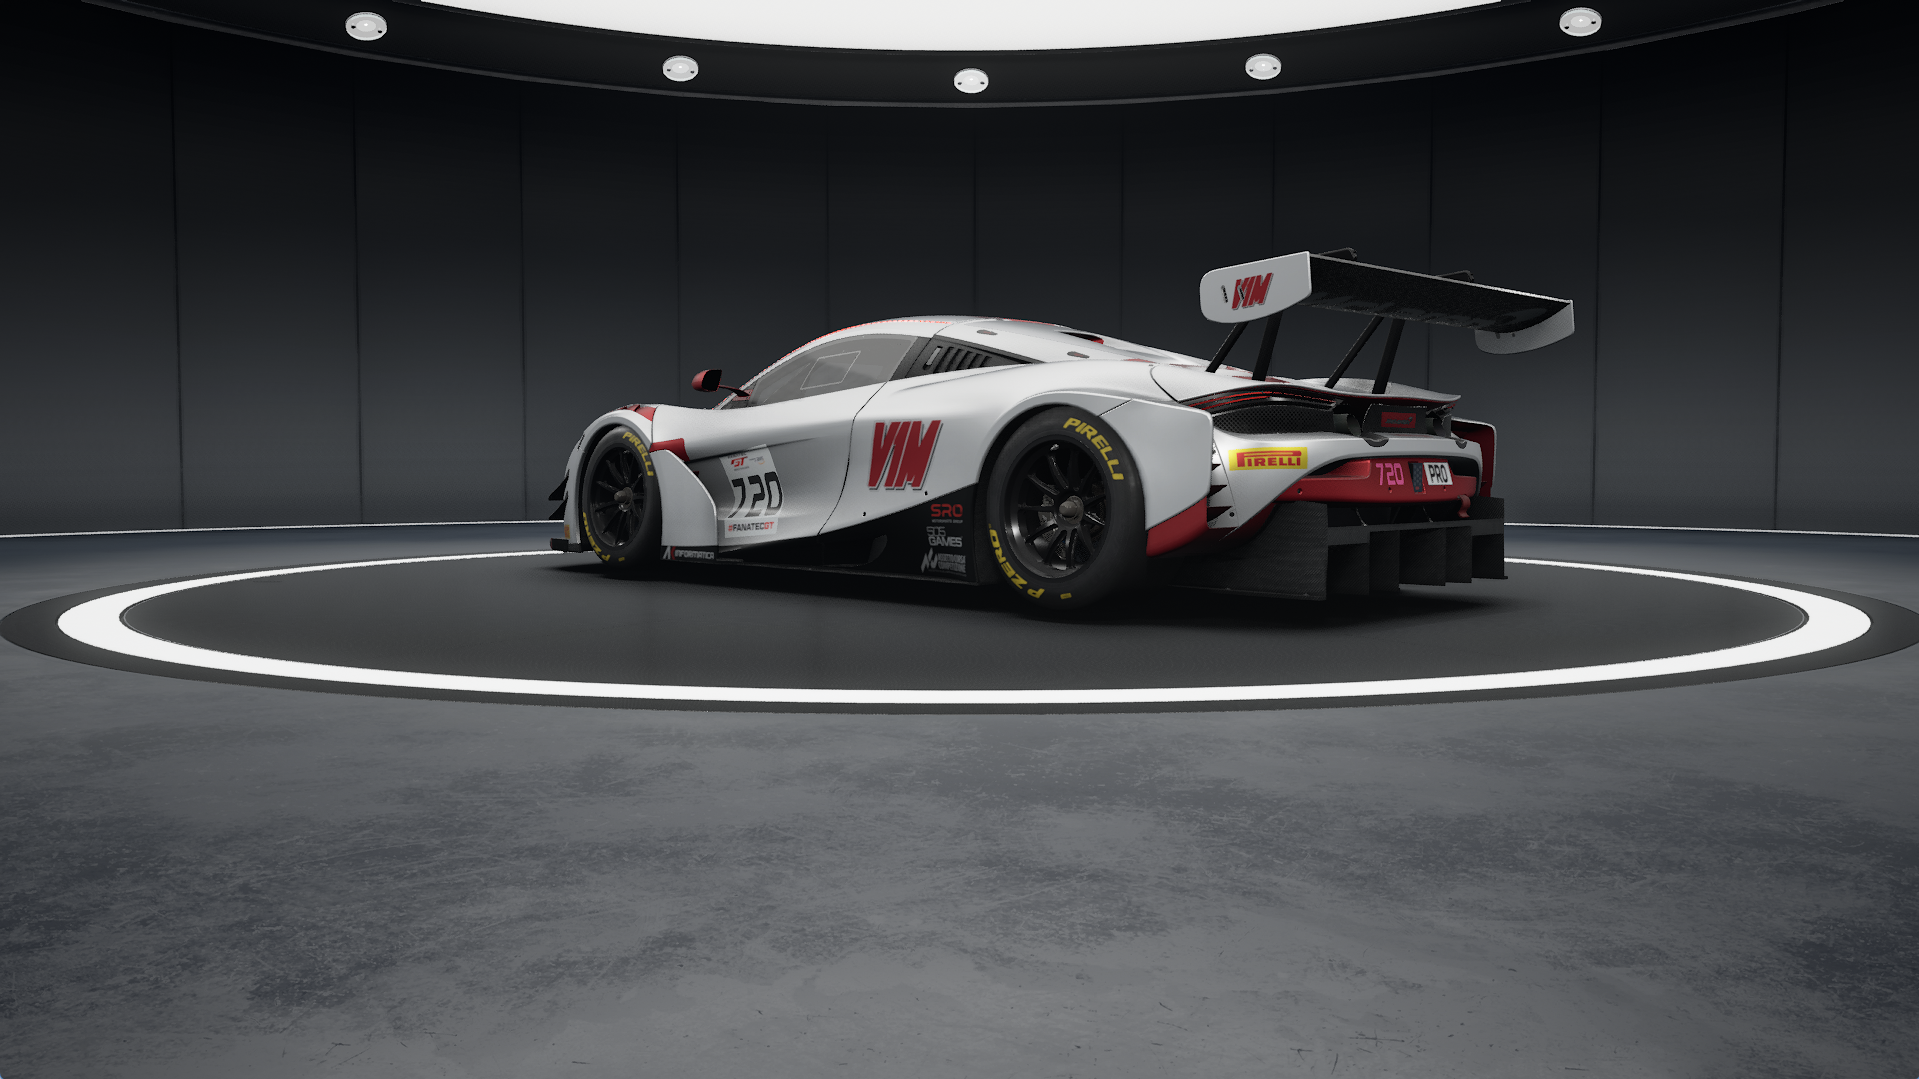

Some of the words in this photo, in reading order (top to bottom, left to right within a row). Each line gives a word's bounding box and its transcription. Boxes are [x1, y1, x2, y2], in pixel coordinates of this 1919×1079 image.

[1232, 272, 1274, 310] VIM
[622, 431, 654, 476] PIRELLI
[868, 419, 943, 490] VIM
[1063, 417, 1124, 481] PIRELLI
[1237, 450, 1301, 467] PIRELLI
[1376, 462, 1405, 486] 720
[1428, 464, 1448, 483] PRO
[728, 471, 783, 518] 720
[930, 503, 963, 518] SRO
[928, 536, 963, 548] GAMES
[989, 529, 1028, 590] ZERO
[1027, 588, 1045, 599] P
